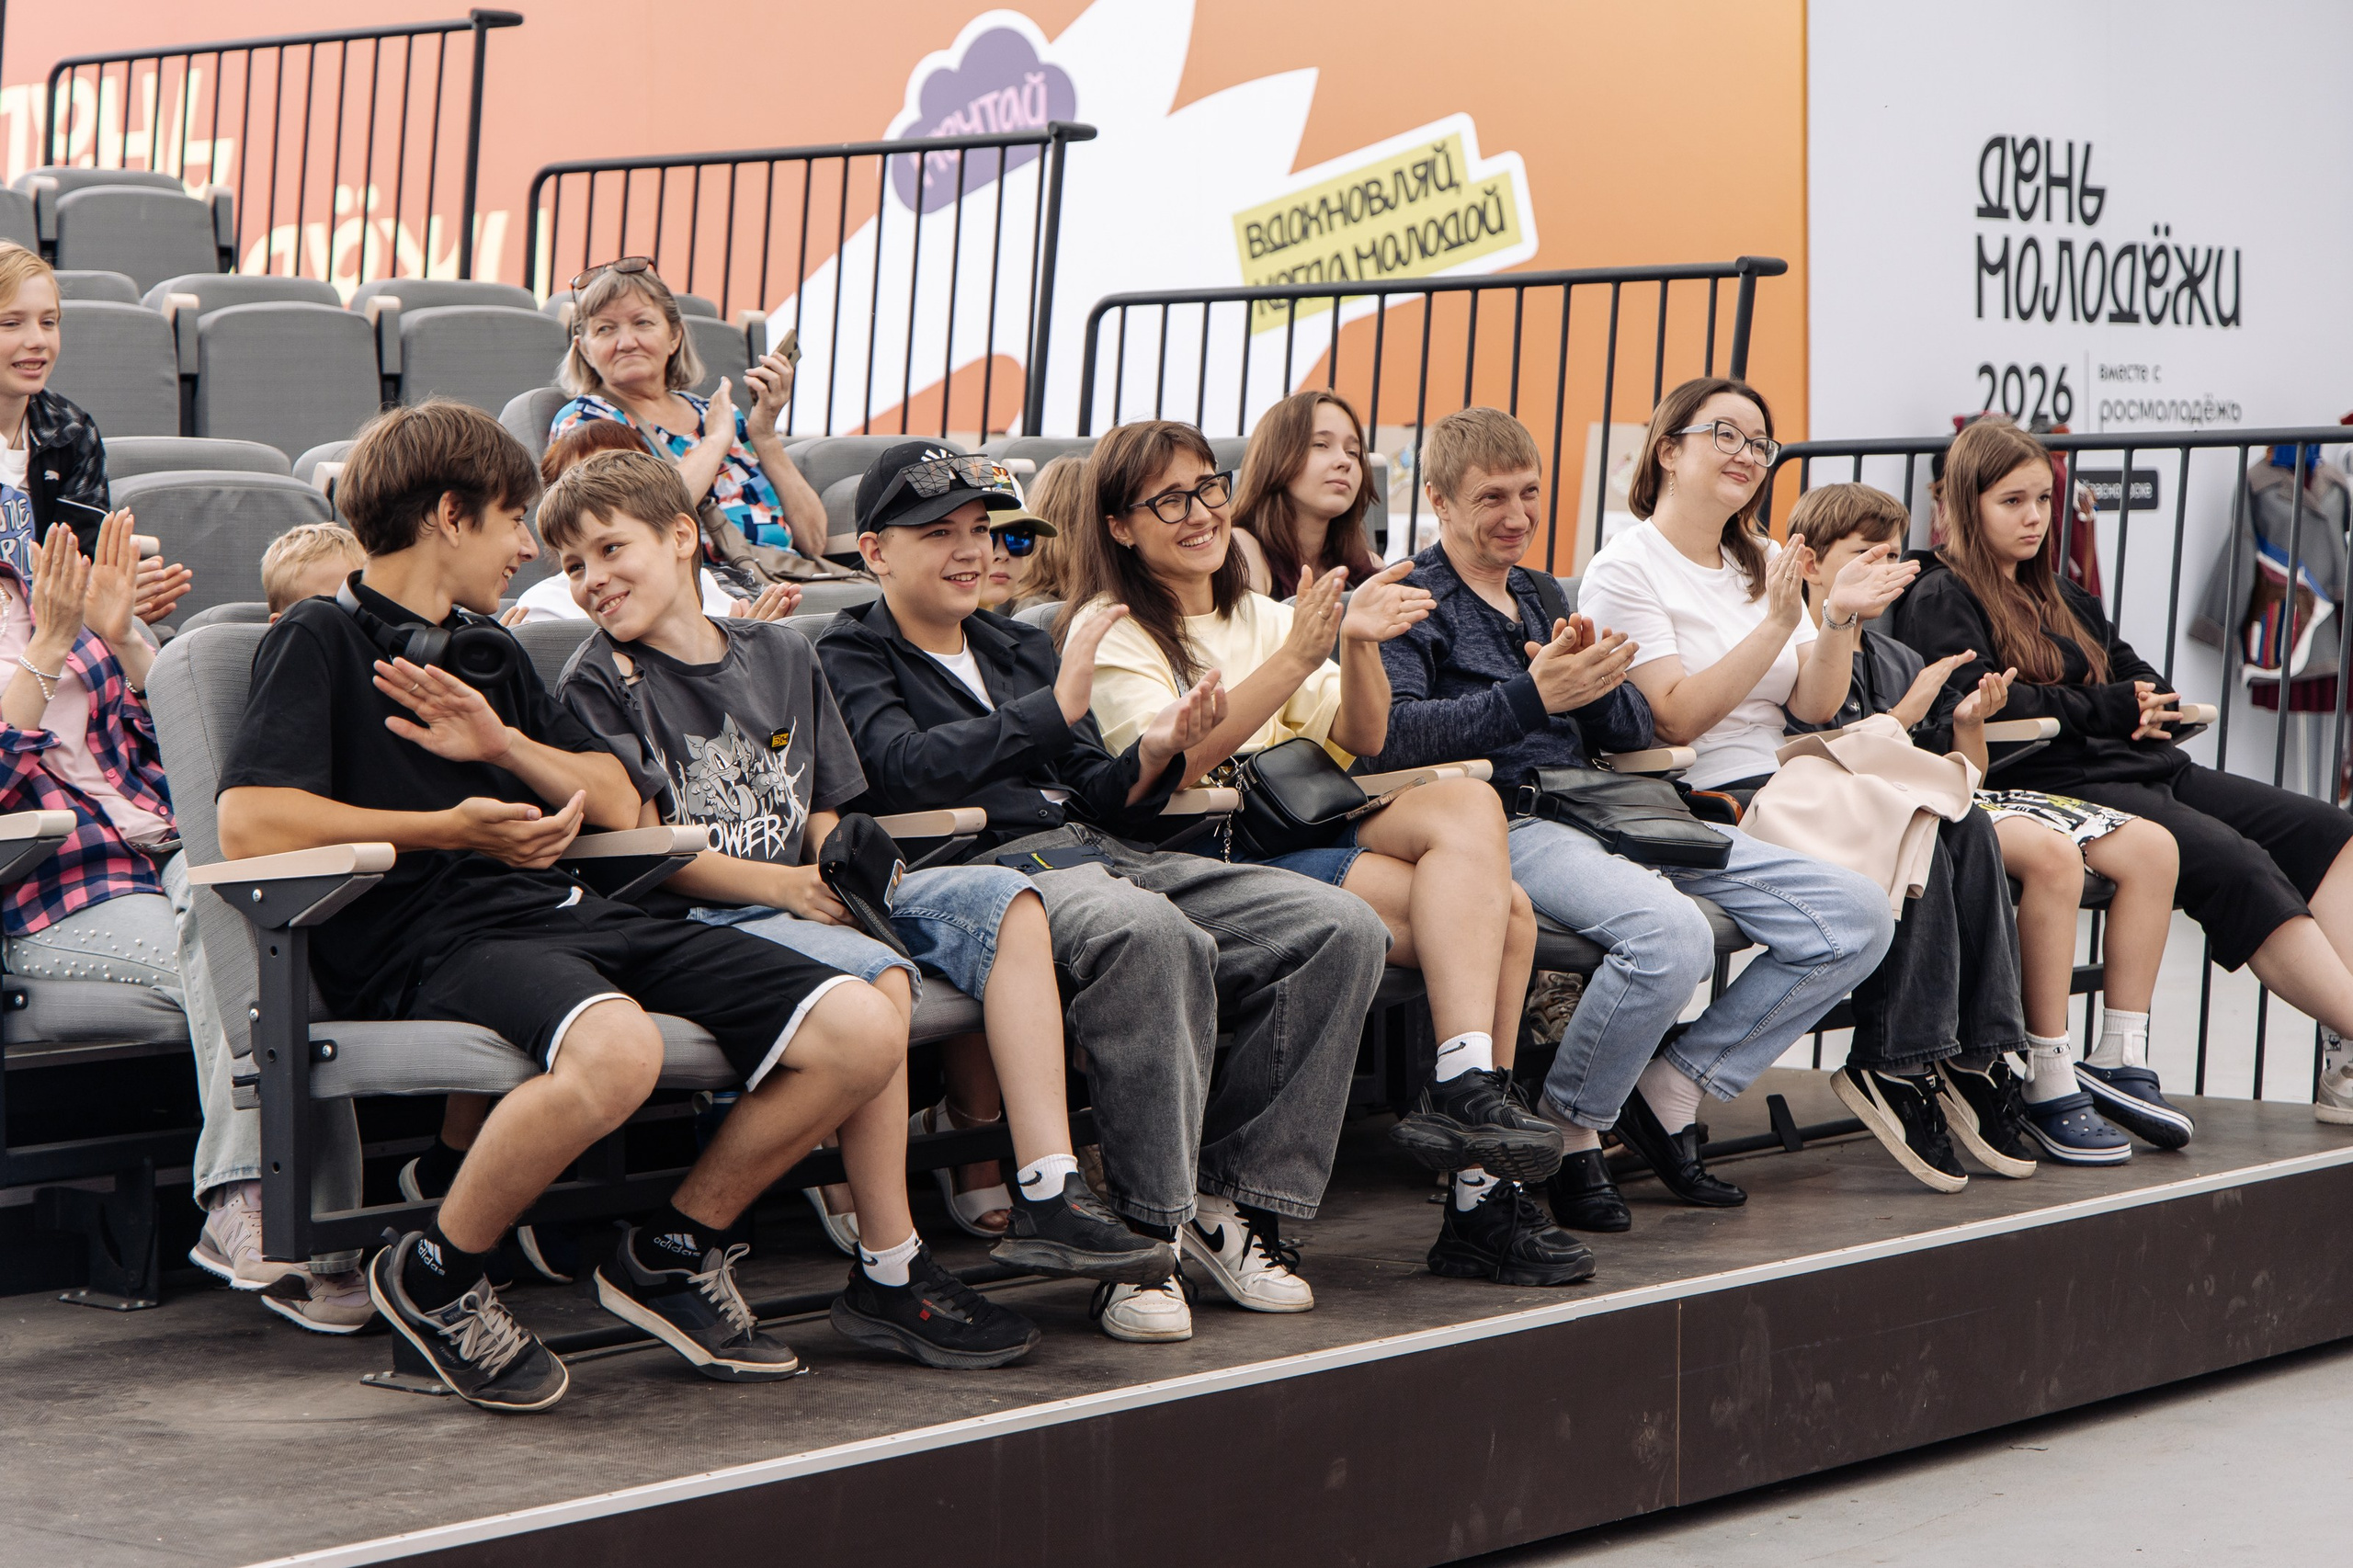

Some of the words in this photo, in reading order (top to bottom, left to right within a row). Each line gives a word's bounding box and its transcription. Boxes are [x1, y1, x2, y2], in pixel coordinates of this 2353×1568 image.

[2099, 364, 2149, 382] вместе
[1977, 364, 2074, 423] 2026
[2099, 392, 2242, 431] росмолодёжь
[706, 808, 786, 860] OWER
[654, 1236, 701, 1257] adidas
